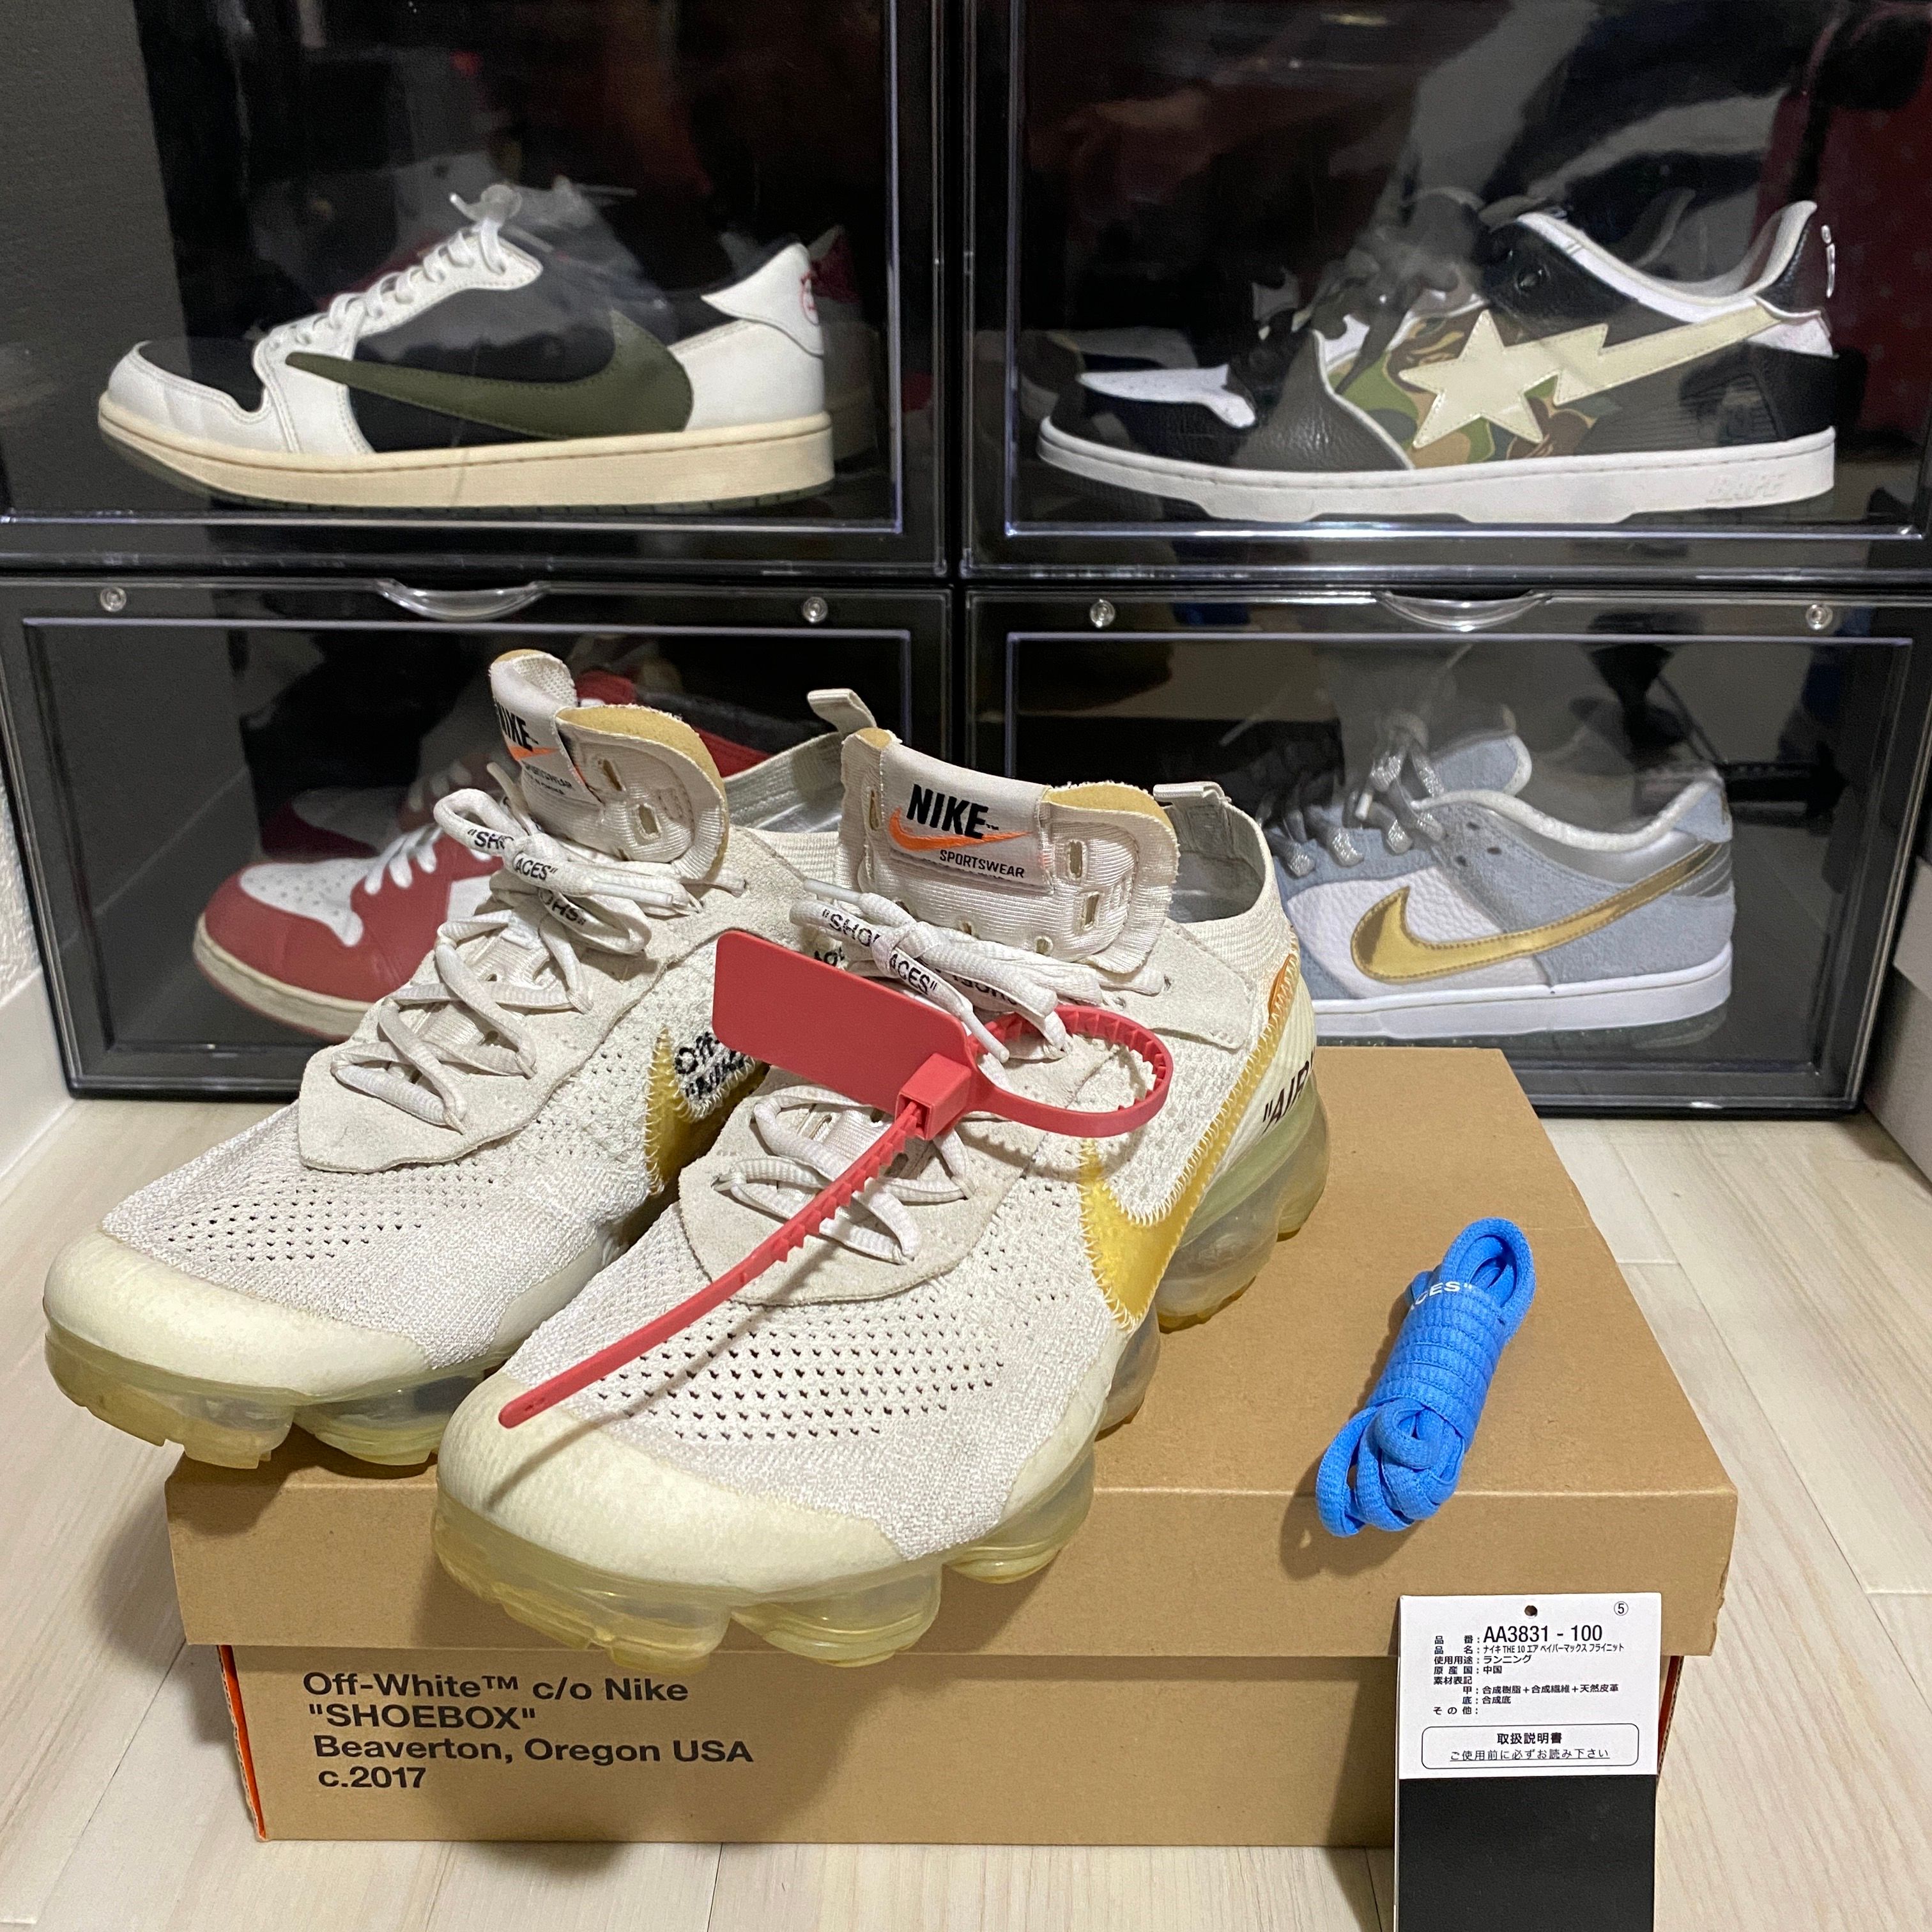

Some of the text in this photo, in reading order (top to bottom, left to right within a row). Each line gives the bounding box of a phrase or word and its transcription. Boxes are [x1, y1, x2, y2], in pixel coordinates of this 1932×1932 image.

[939, 850, 1025, 878] SPORTSWEAR
[1483, 1625, 1548, 1643] AA3831
[1570, 1625, 1603, 1641] 100
[1502, 1645, 1515, 1653] THE
[1517, 1644, 1526, 1653] 10
[1483, 1654, 1532, 1664] ランニング
[1483, 1665, 1503, 1675] 中国
[532, 1676, 592, 1700] c/o
[604, 1678, 689, 1701] Nike
[1433, 1676, 1473, 1685] 素材表記
[309, 1703, 535, 1730] "SHOEBOX"
[1497, 1732, 1563, 1744] 取扱説明書
[314, 1735, 755, 1766] Beaverton, Oregon USA
[1450, 1747, 1609, 1761] ご使用前に必ずお読み下さい
[318, 1765, 427, 1788] c.2017
